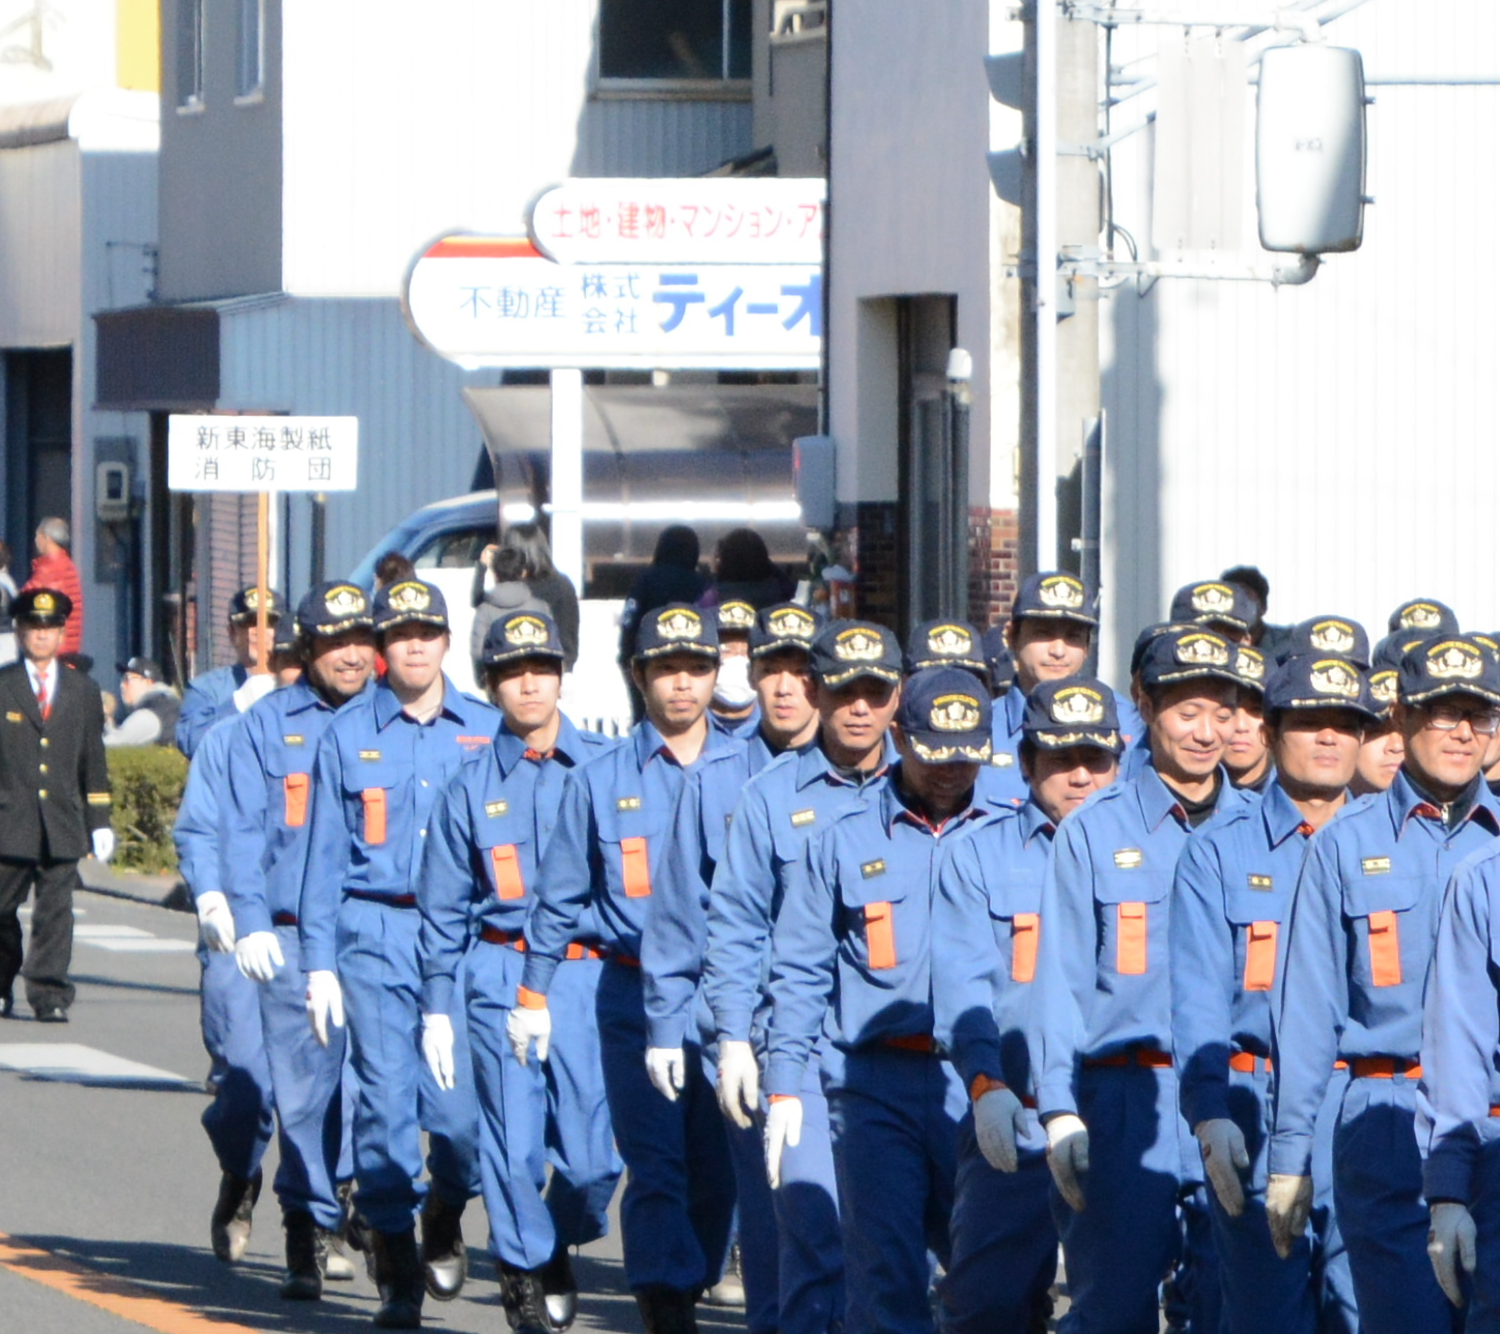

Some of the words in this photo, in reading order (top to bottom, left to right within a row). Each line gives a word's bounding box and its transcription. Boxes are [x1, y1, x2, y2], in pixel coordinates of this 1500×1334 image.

[552, 202, 823, 239] 土地・建物・マンション・ア
[459, 286, 565, 319] 不動産
[196, 426, 332, 451] 新東海製紙
[195, 456, 331, 481] 消防団
